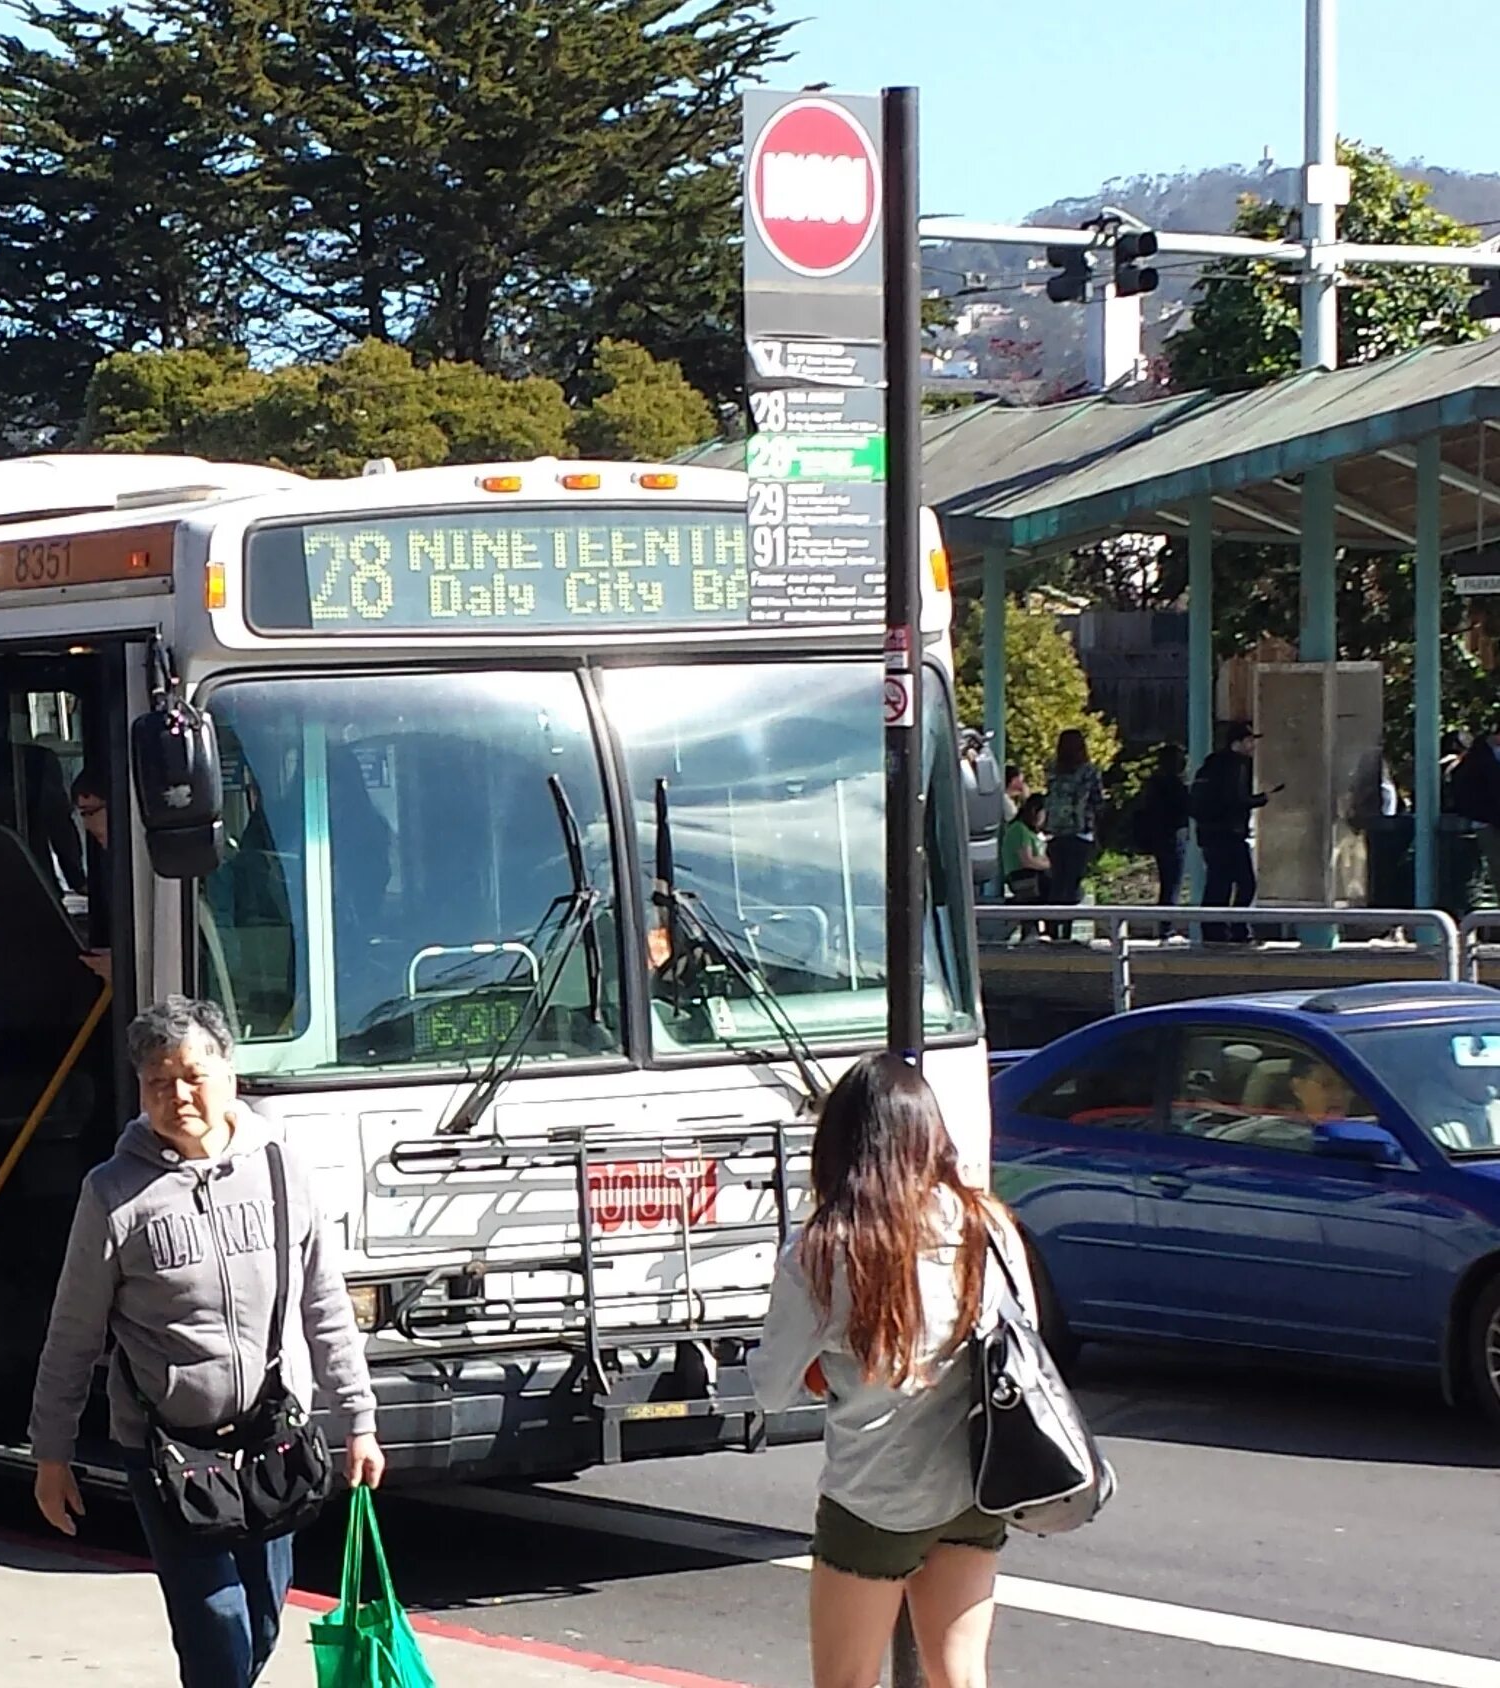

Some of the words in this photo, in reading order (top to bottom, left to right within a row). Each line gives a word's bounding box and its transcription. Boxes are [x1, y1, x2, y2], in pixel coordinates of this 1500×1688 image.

[748, 482, 785, 525] 29
[15, 541, 71, 583] 8351
[753, 526, 785, 568] 91
[304, 530, 393, 620] 28
[408, 526, 746, 571] NINETEENTH
[429, 573, 535, 618] Daly
[566, 570, 664, 615] City
